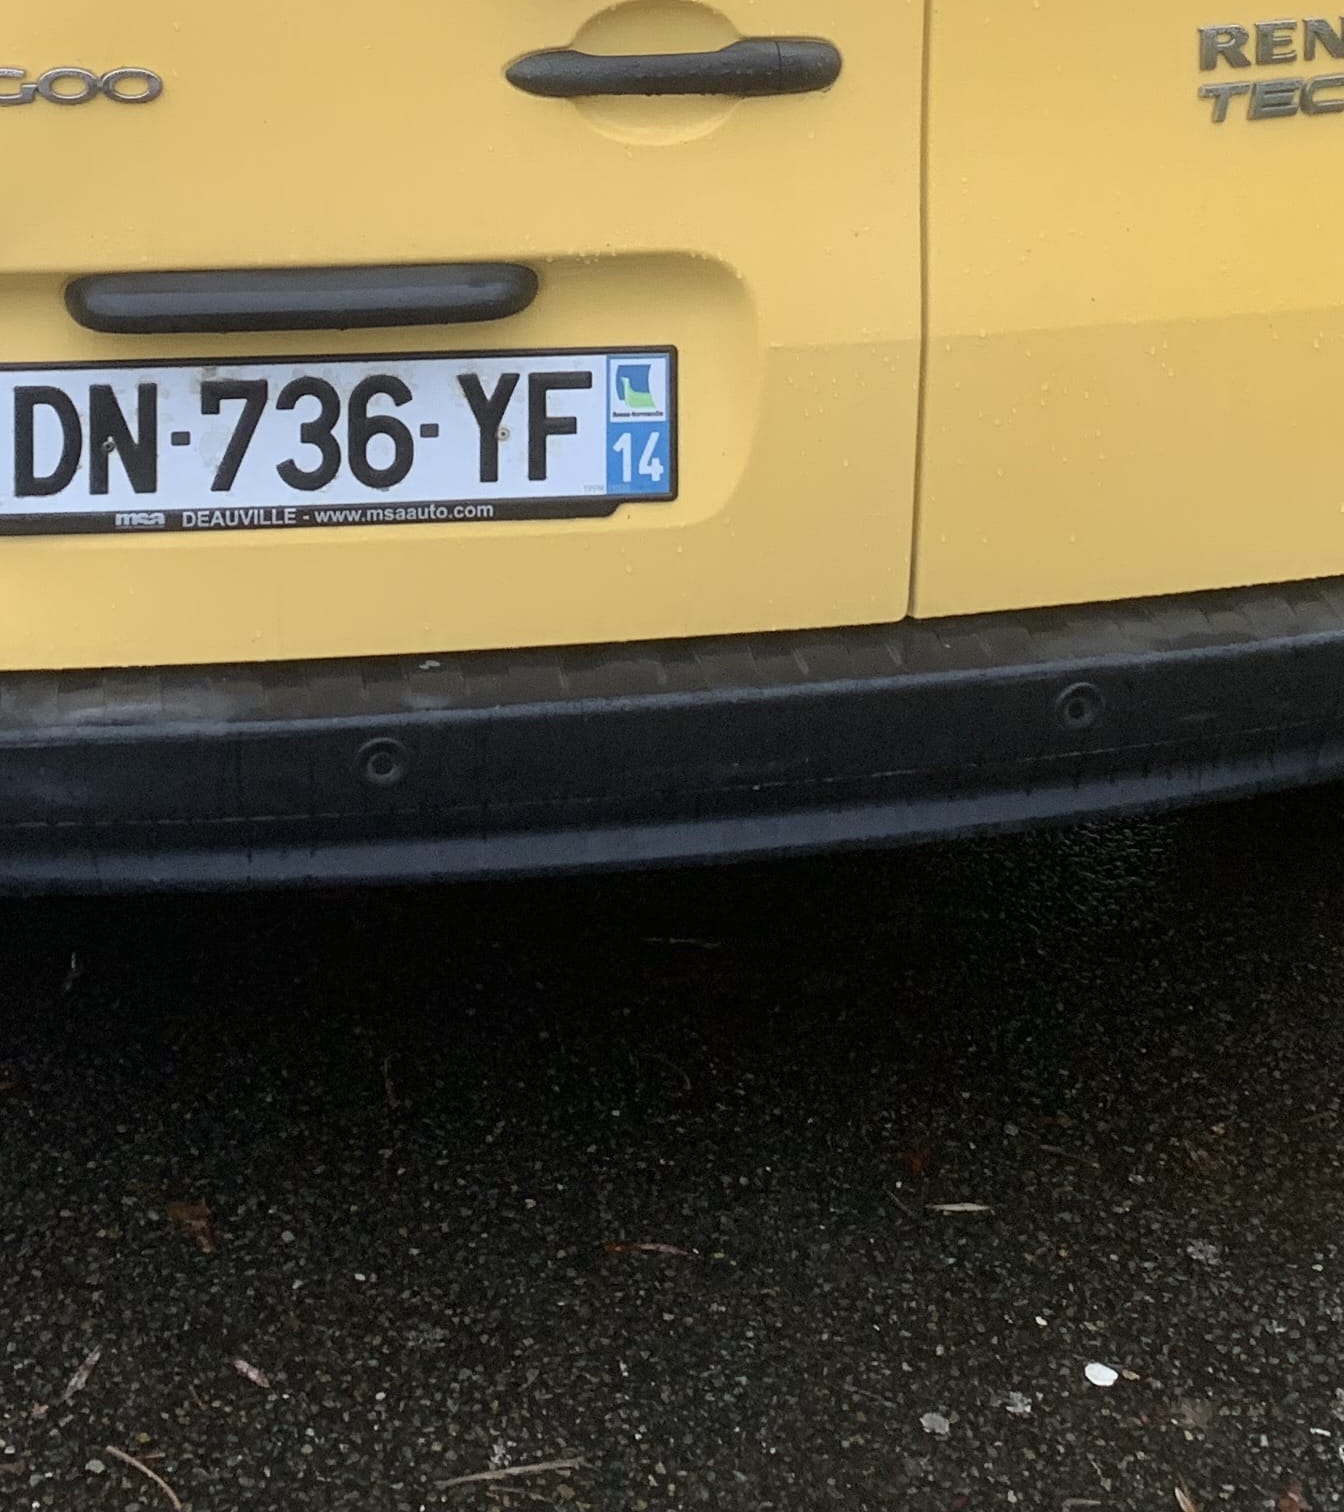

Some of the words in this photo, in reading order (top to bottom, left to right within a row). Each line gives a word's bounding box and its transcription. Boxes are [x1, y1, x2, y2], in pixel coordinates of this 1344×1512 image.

[12, 370, 593, 497] DN-736-YF
[612, 431, 665, 483] 14
[182, 507, 297, 529] DEAUVILLE
[314, 503, 494, 524] www.msaauto.com
